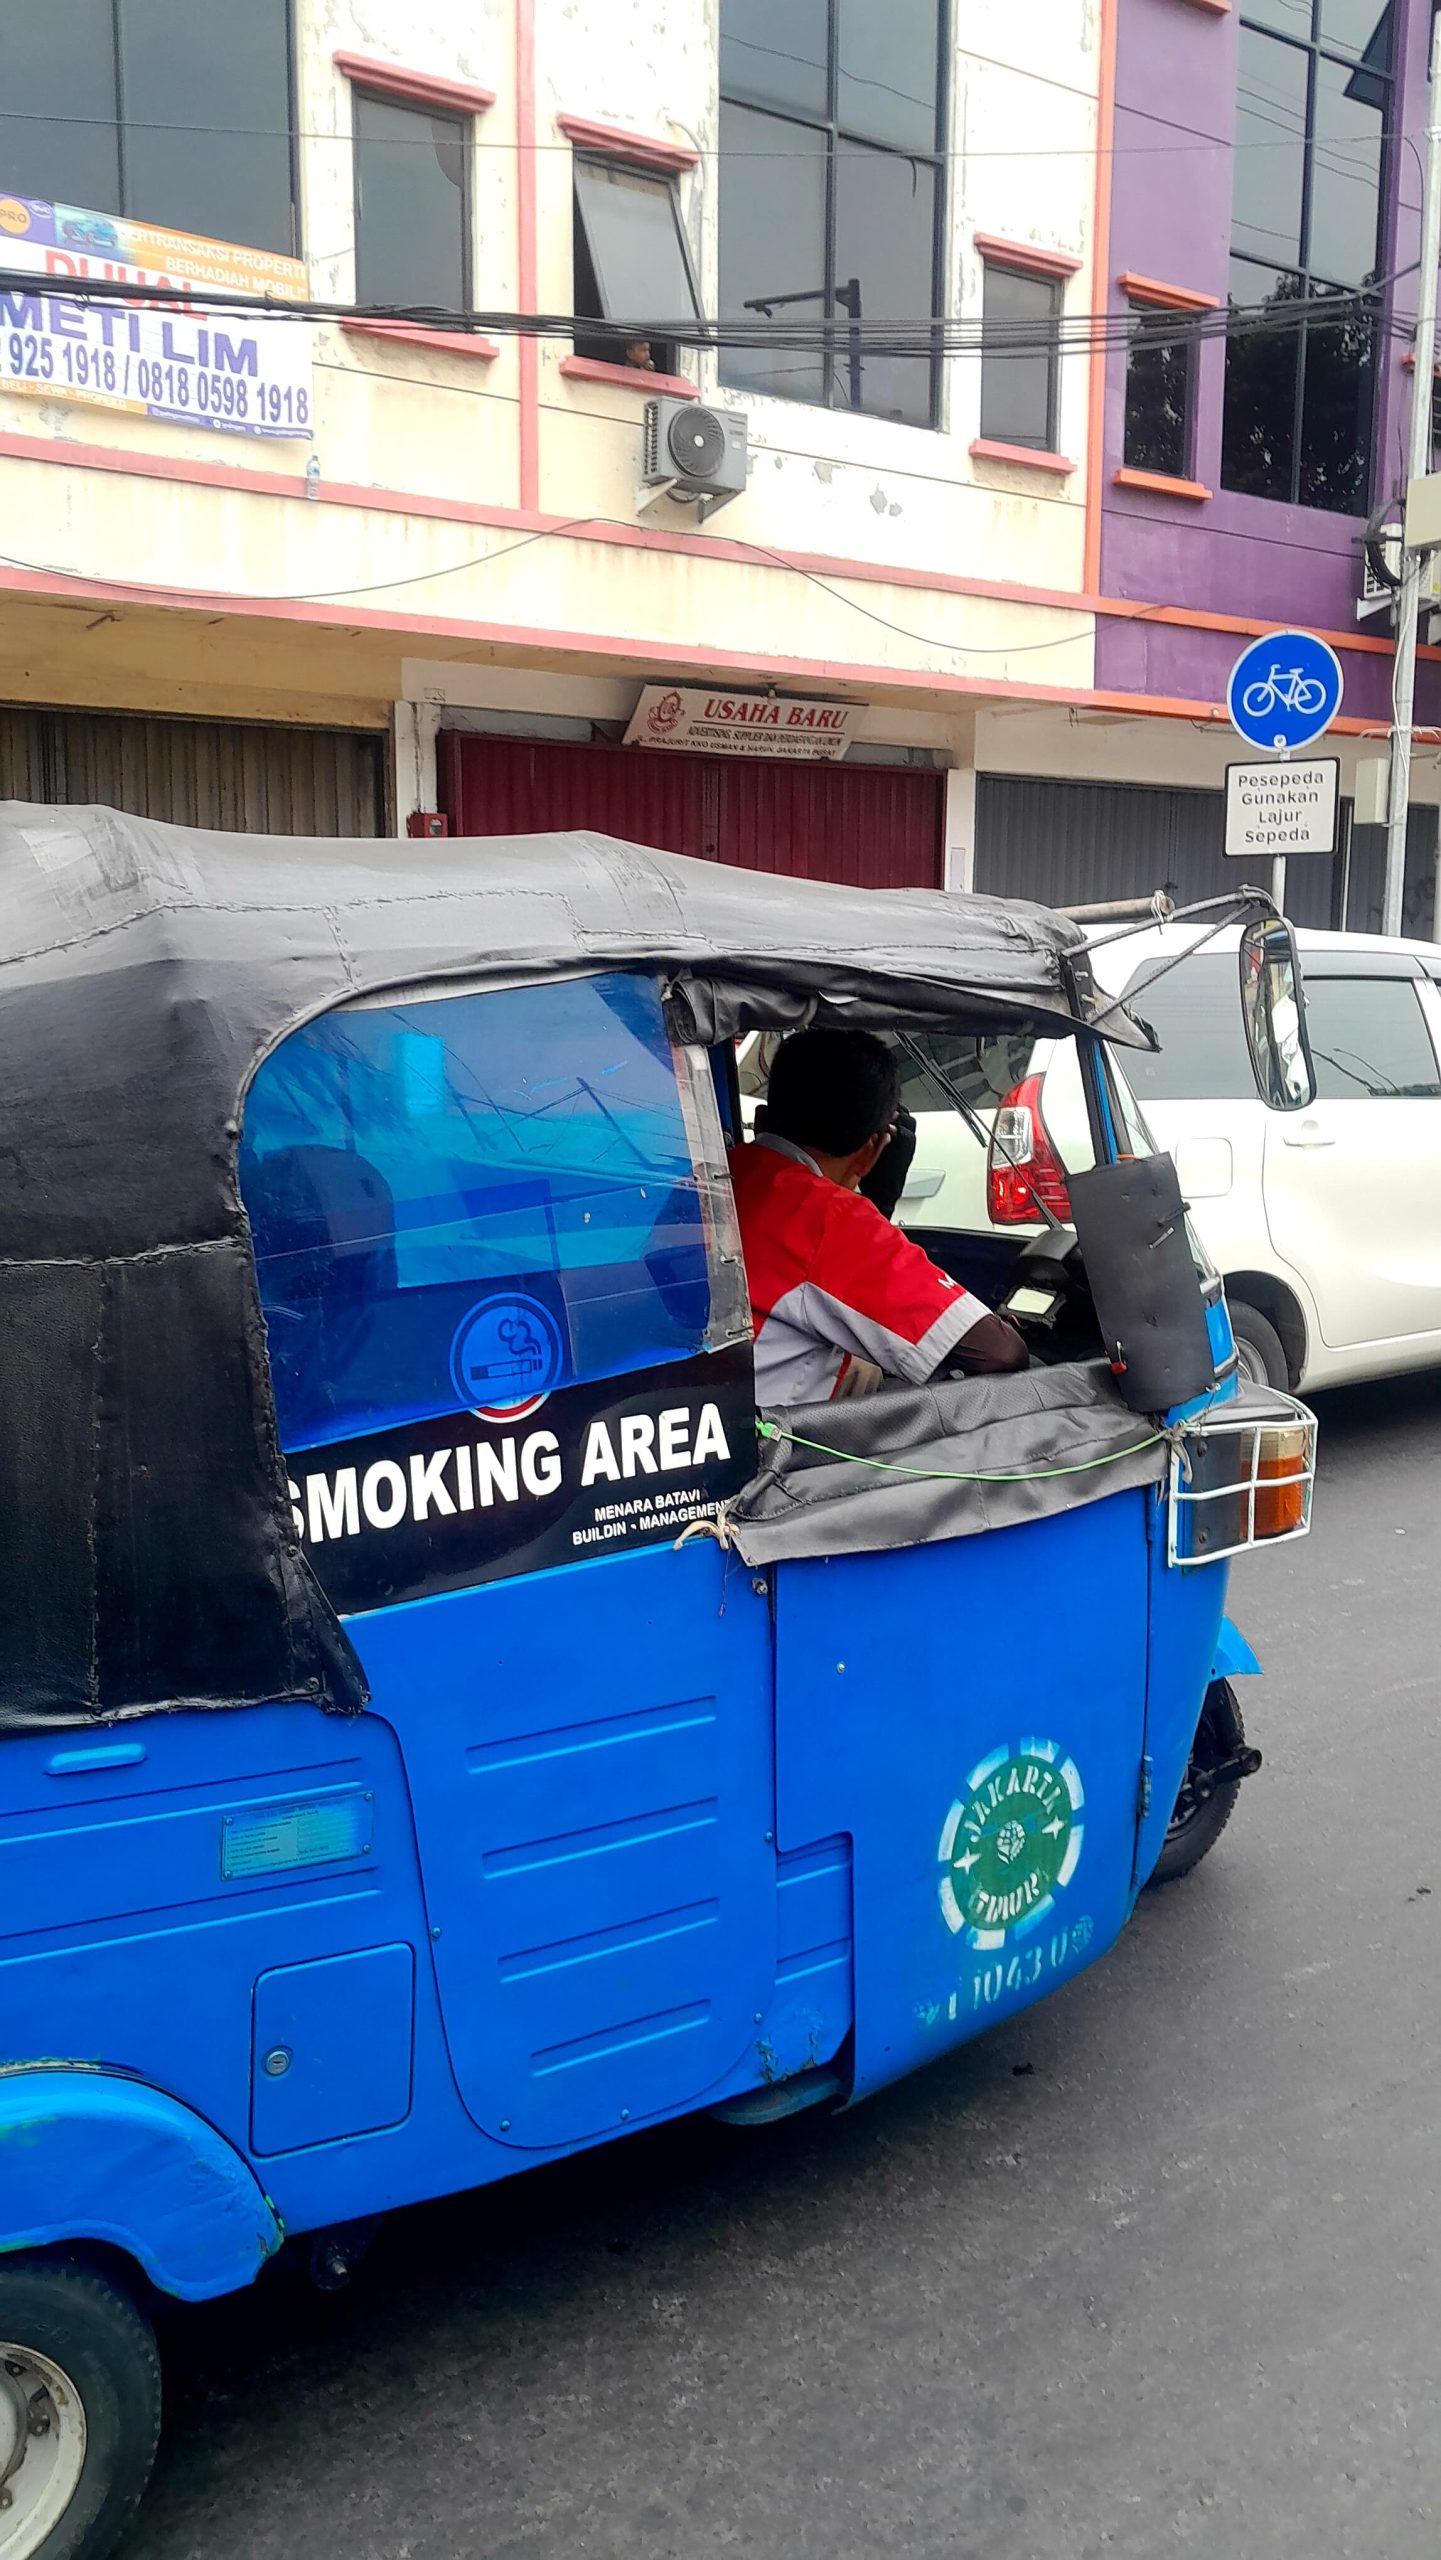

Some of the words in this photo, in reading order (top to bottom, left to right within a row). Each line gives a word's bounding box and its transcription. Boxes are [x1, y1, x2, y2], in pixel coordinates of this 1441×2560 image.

[165, 256, 249, 288] BERHADIAH
[233, 250, 306, 279] PROPERTI
[161, 321, 258, 377] LIM
[9, 333, 54, 378] 925
[63, 342, 115, 391] 1918
[138, 359, 190, 408] 0818
[197, 371, 248, 418] 0598
[257, 383, 308, 424] 1918
[703, 699, 780, 724] USAHA
[785, 707, 849, 729] BARU
[1238, 771, 1324, 788] Pesepeda
[1241, 790, 1319, 805] Gunakan
[1259, 809, 1303, 826] Lajur
[1244, 828, 1310, 845] Sepeda
[580, 1402, 731, 1487] AREA
[594, 1498, 653, 1523] MENARA
